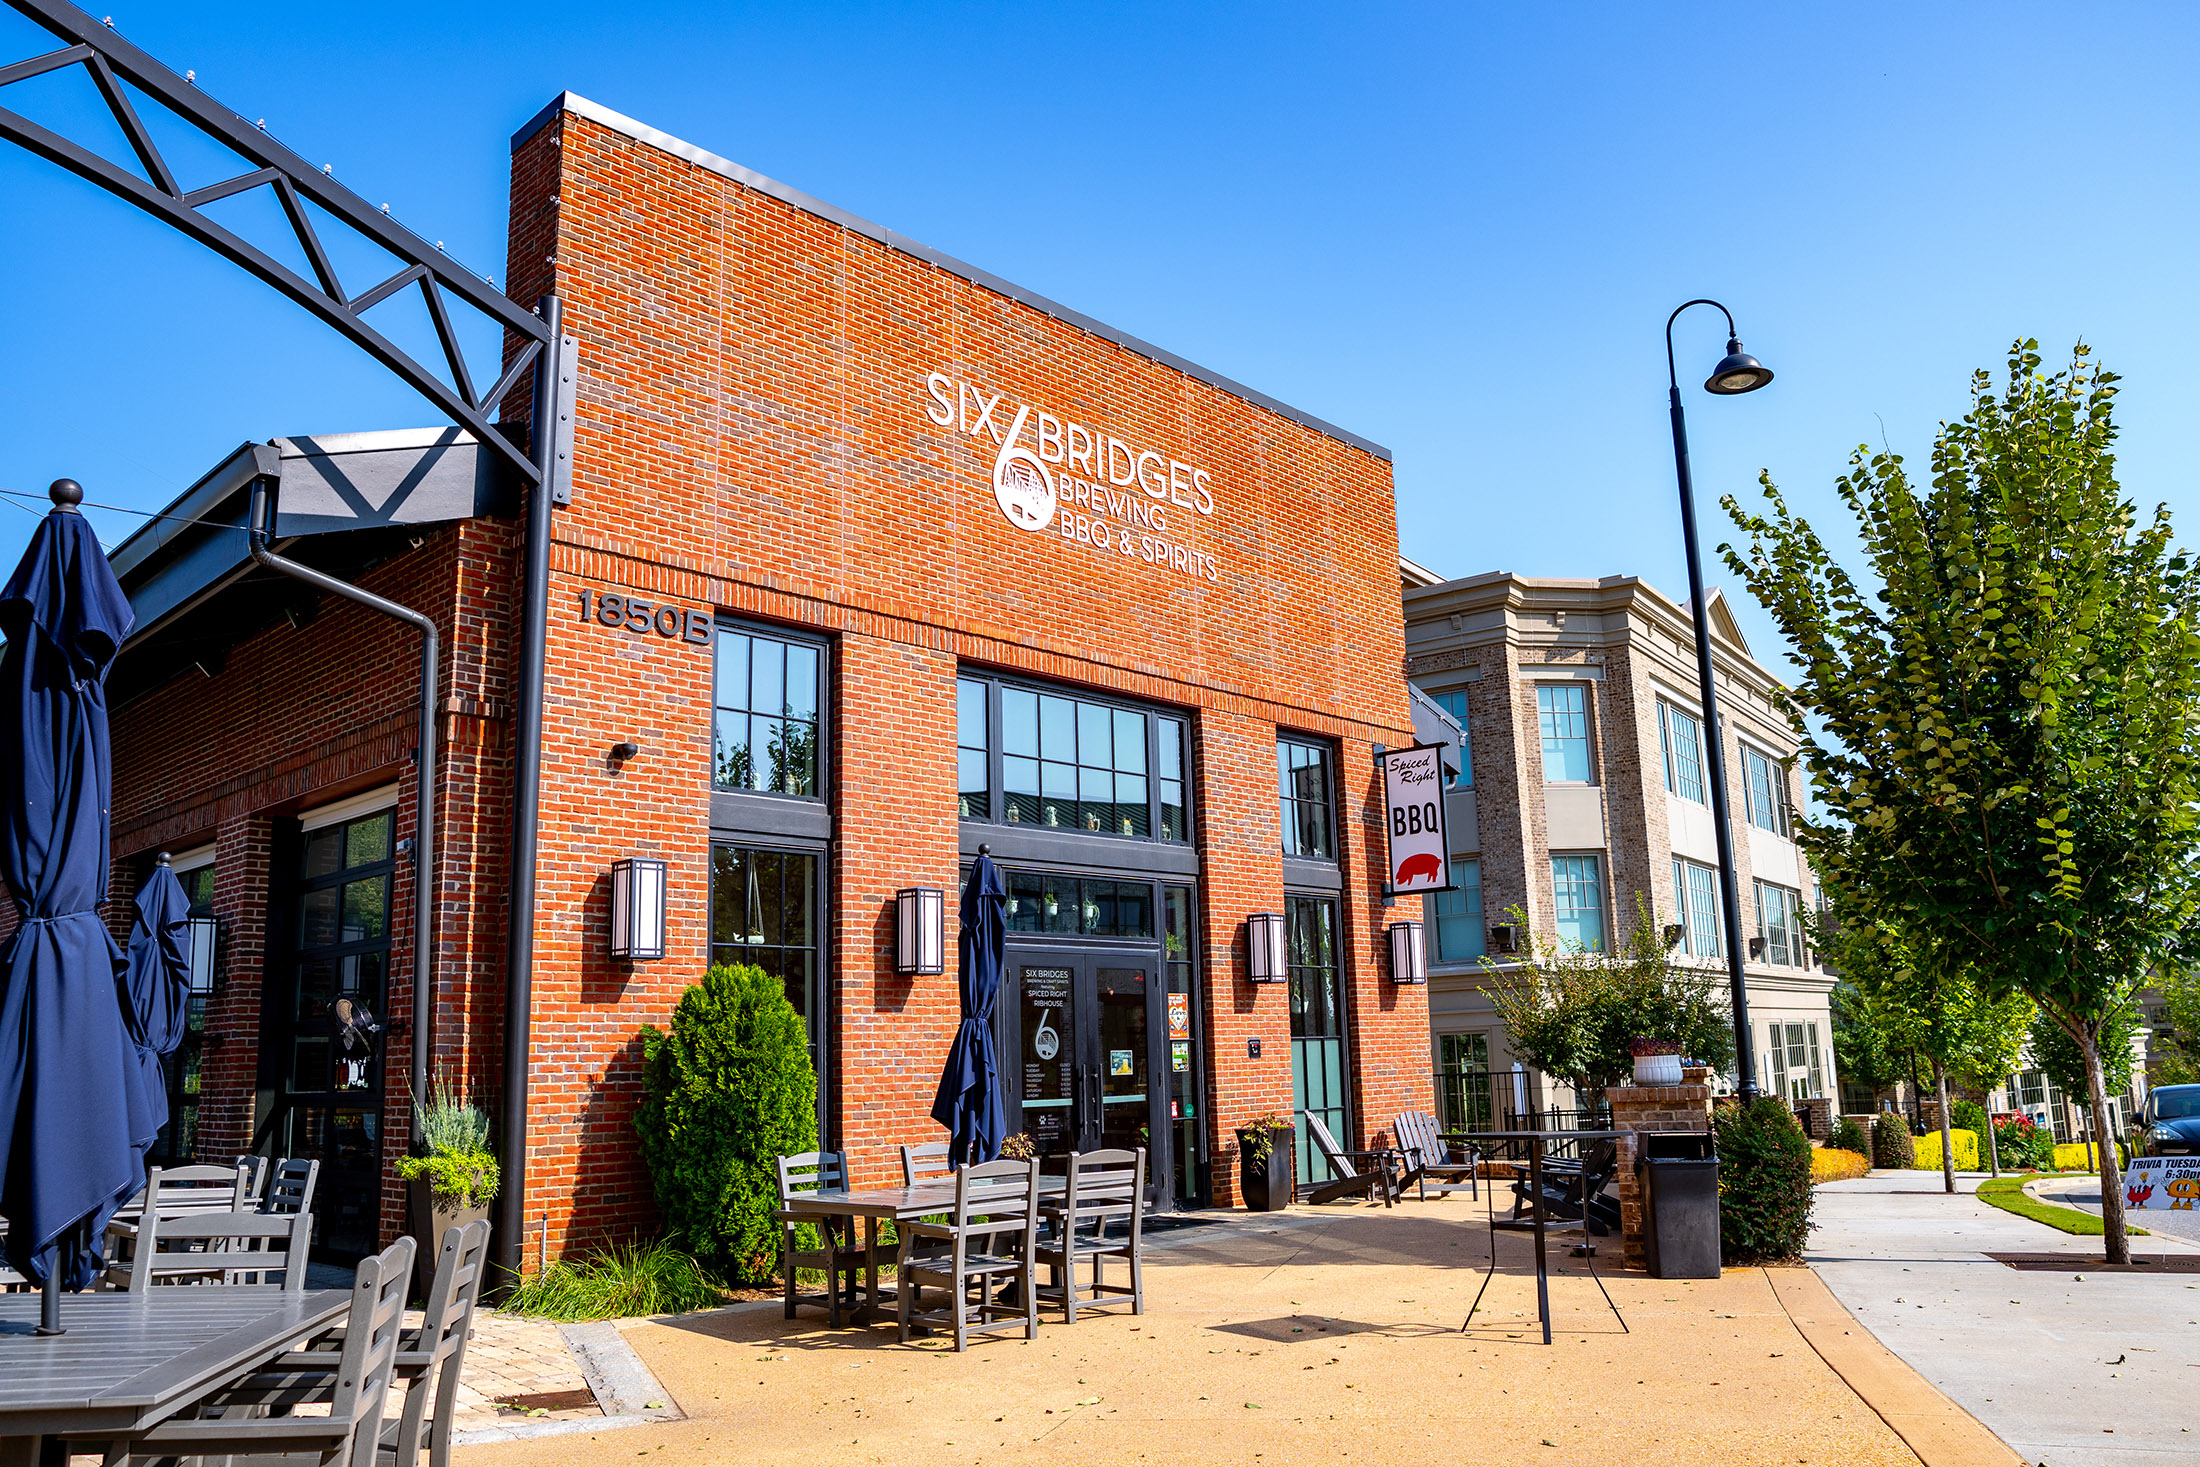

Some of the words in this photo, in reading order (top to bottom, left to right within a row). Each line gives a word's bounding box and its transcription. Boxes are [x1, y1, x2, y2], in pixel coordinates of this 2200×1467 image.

[926, 372, 1002, 446] SIX
[992, 404, 1056, 532] 6
[1038, 411, 1214, 516] BRIDGES
[1058, 472, 1166, 532] BREWING
[1060, 510, 1112, 551] BBQ
[1119, 529, 1135, 558] &
[1141, 535, 1218, 582] SPIRITS
[579, 588, 715, 645] 1850B
[1389, 755, 1431, 773] Spiced
[1400, 768, 1436, 786] Right
[1393, 801, 1439, 837] BBQ
[1025, 969, 1037, 978] SIX
[1038, 969, 1069, 979] BRIDGES
[1028, 990, 1049, 998] SPICED
[1050, 990, 1067, 998] RIGHT
[1033, 1000, 1064, 1008] RIBHOUSE
[2132, 1160, 2162, 1170] TRIVIA
